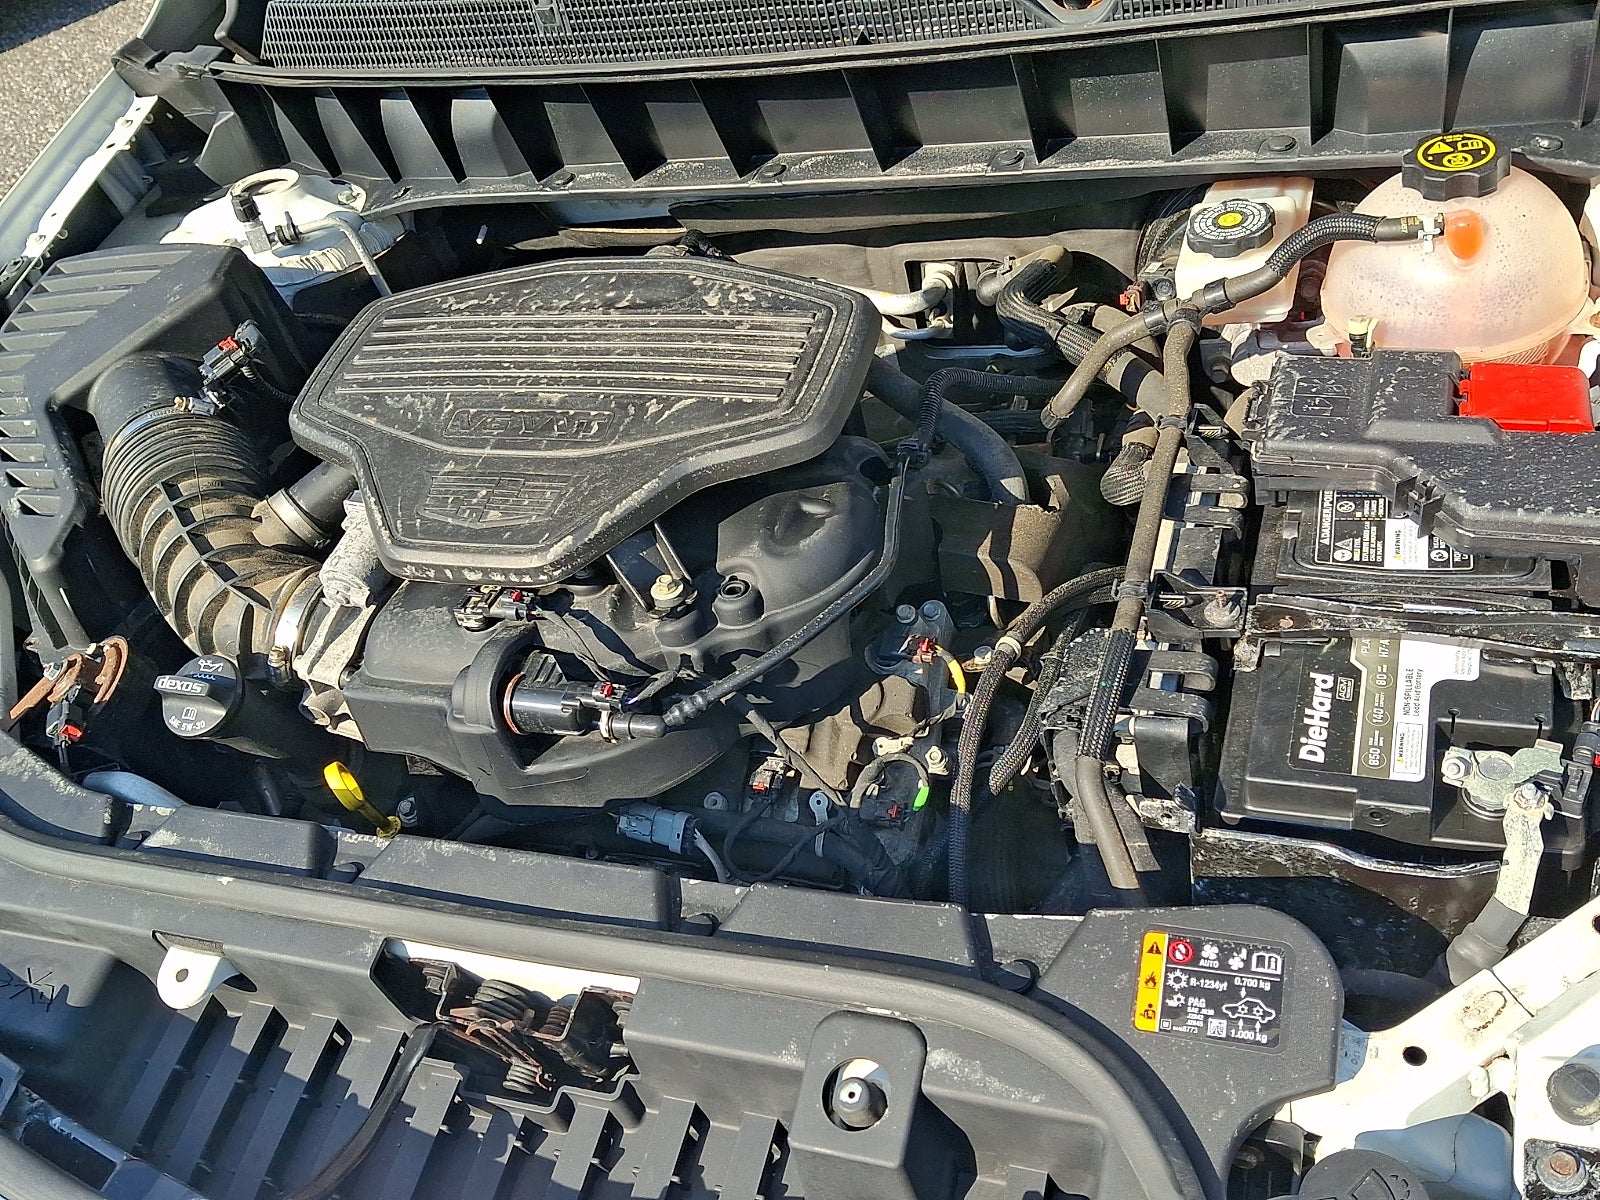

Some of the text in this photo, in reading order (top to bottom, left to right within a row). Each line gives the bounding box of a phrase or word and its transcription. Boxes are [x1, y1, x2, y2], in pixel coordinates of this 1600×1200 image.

[1322, 490, 1333, 537] DANGER/POIS
[157, 677, 203, 693] dexos
[1375, 674, 1387, 686] 80
[1414, 668, 1424, 689] Battery
[1338, 679, 1347, 698] AGM
[1402, 668, 1415, 716] NON-SPILLABLE
[1413, 689, 1421, 702] Acid
[1298, 671, 1335, 764] DieHard
[1373, 708, 1385, 723] 140
[1412, 703, 1421, 717] Lead
[168, 715, 206, 731] SAE 5W-30
[1368, 748, 1380, 766] 850
[1199, 960, 1219, 968] AUTO
[1190, 977, 1271, 991] R-1234yf 0.700 kg
[1188, 997, 1206, 1008] PAG
[1230, 1028, 1268, 1043] 1.000 kg
